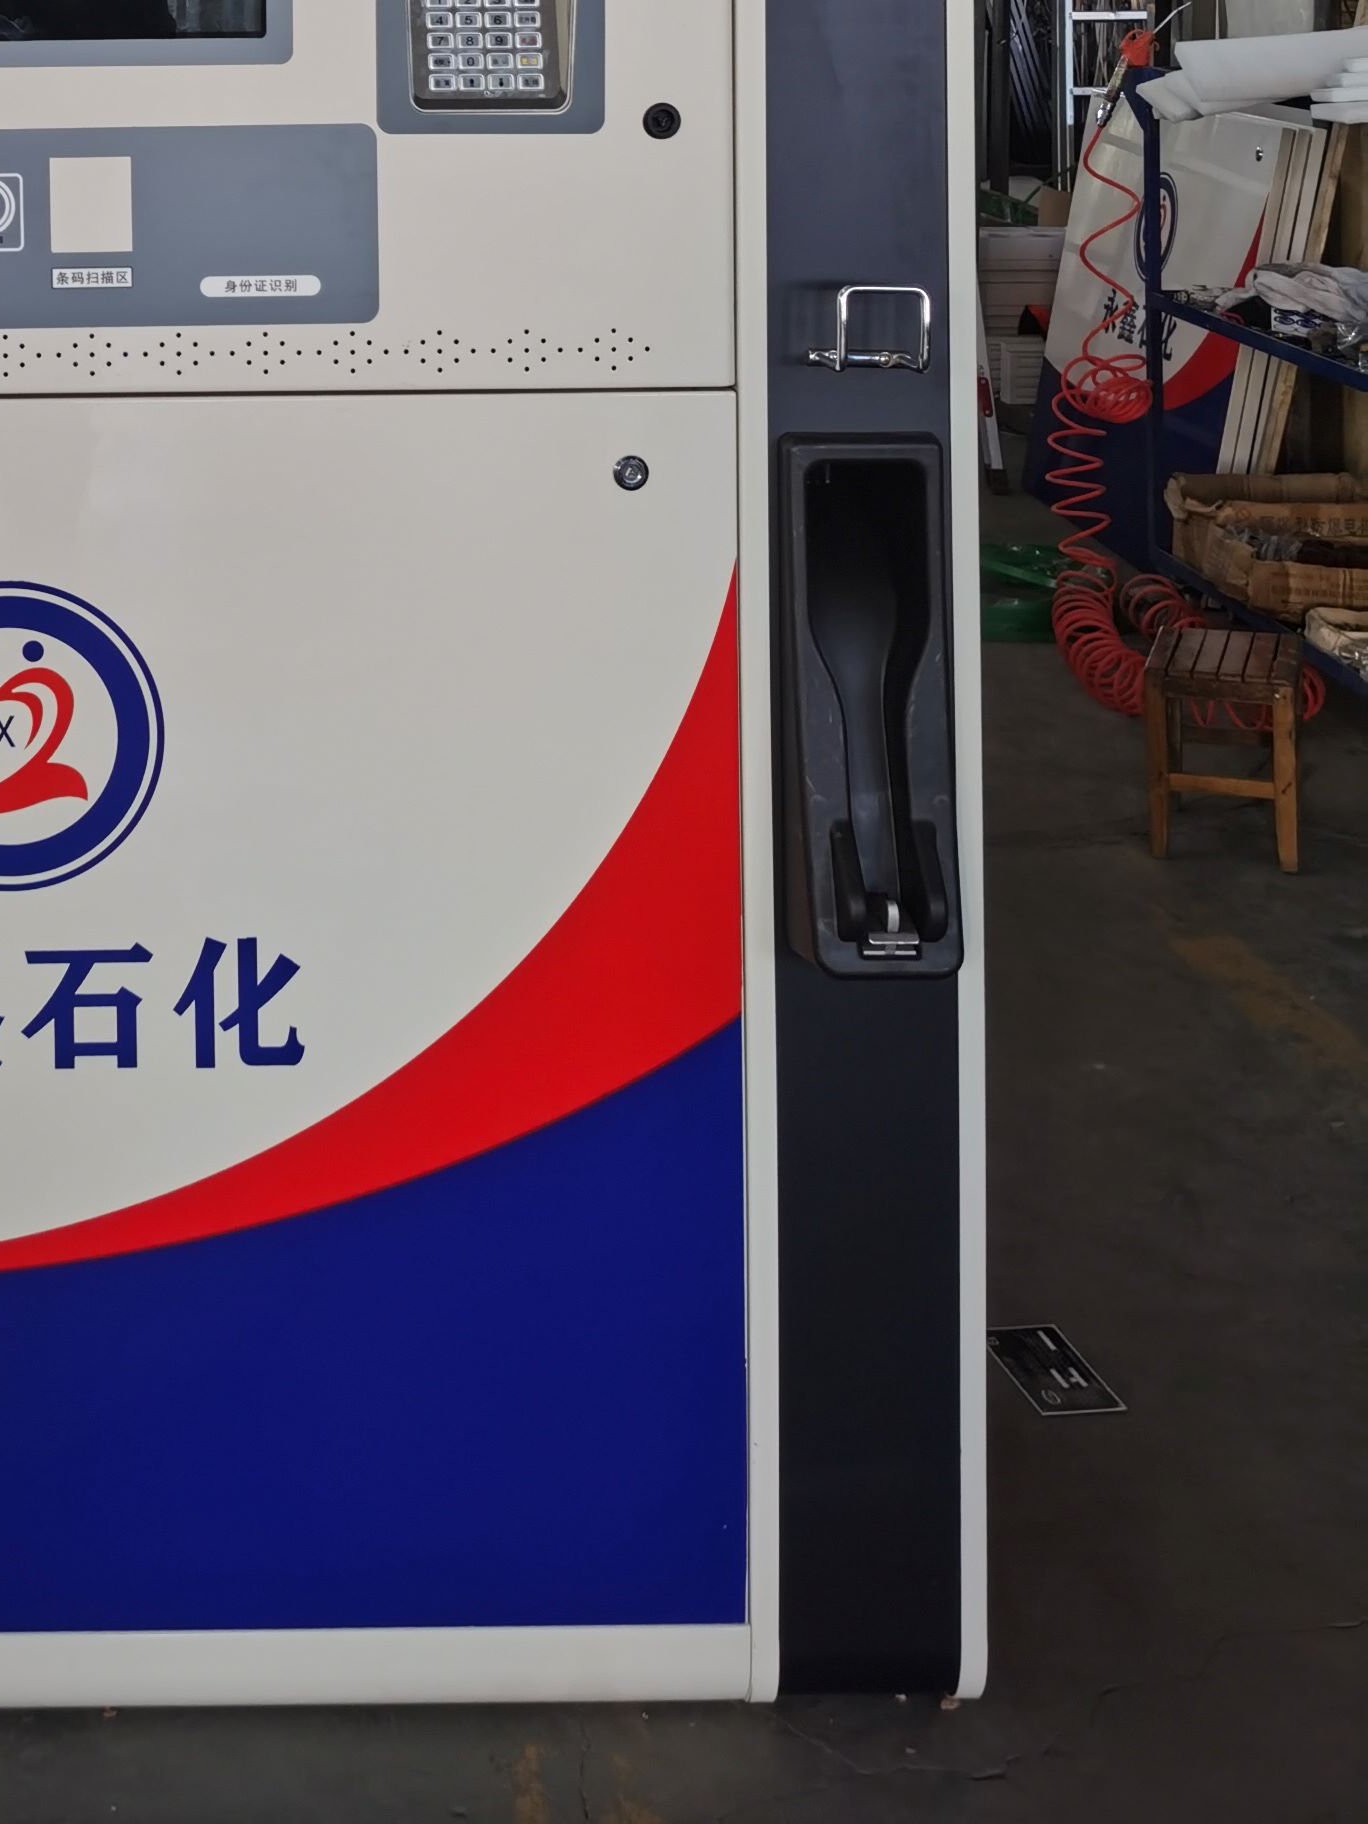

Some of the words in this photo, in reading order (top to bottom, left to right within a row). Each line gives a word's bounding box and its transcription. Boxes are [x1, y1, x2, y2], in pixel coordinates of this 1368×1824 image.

[56, 270, 129, 285] 条码扫描区
[224, 279, 298, 293] 身份证识别
